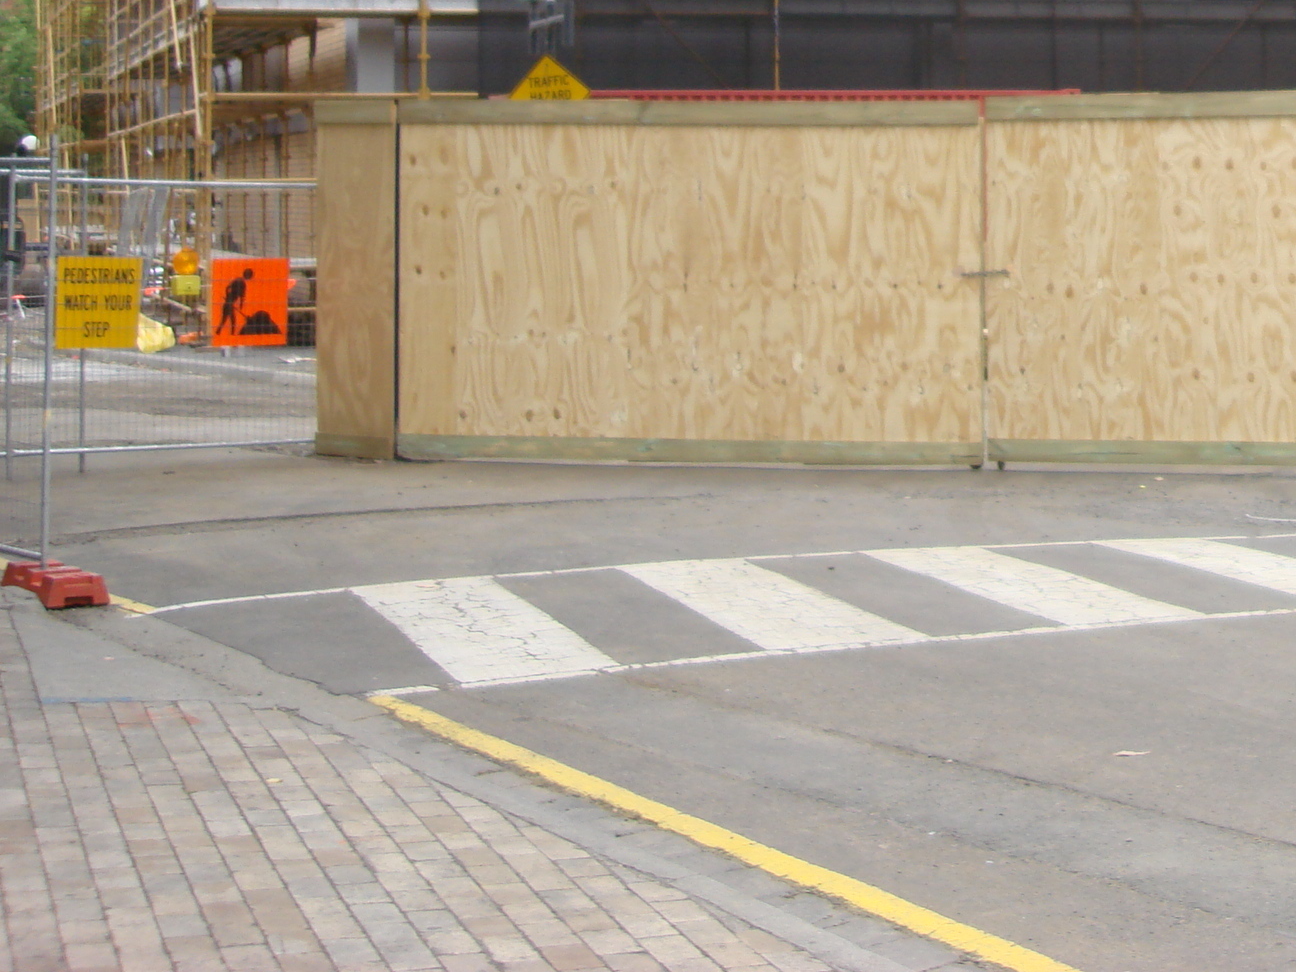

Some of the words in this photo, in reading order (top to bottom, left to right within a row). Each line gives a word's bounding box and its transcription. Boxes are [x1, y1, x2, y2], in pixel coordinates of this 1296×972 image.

[528, 75, 570, 88] TRAFFIC
[530, 90, 571, 100] HAZARD
[64, 268, 135, 285] PEDESTRIANS
[64, 294, 98, 311] WATCH
[104, 294, 132, 311] YOUR
[84, 321, 110, 337] STEP
